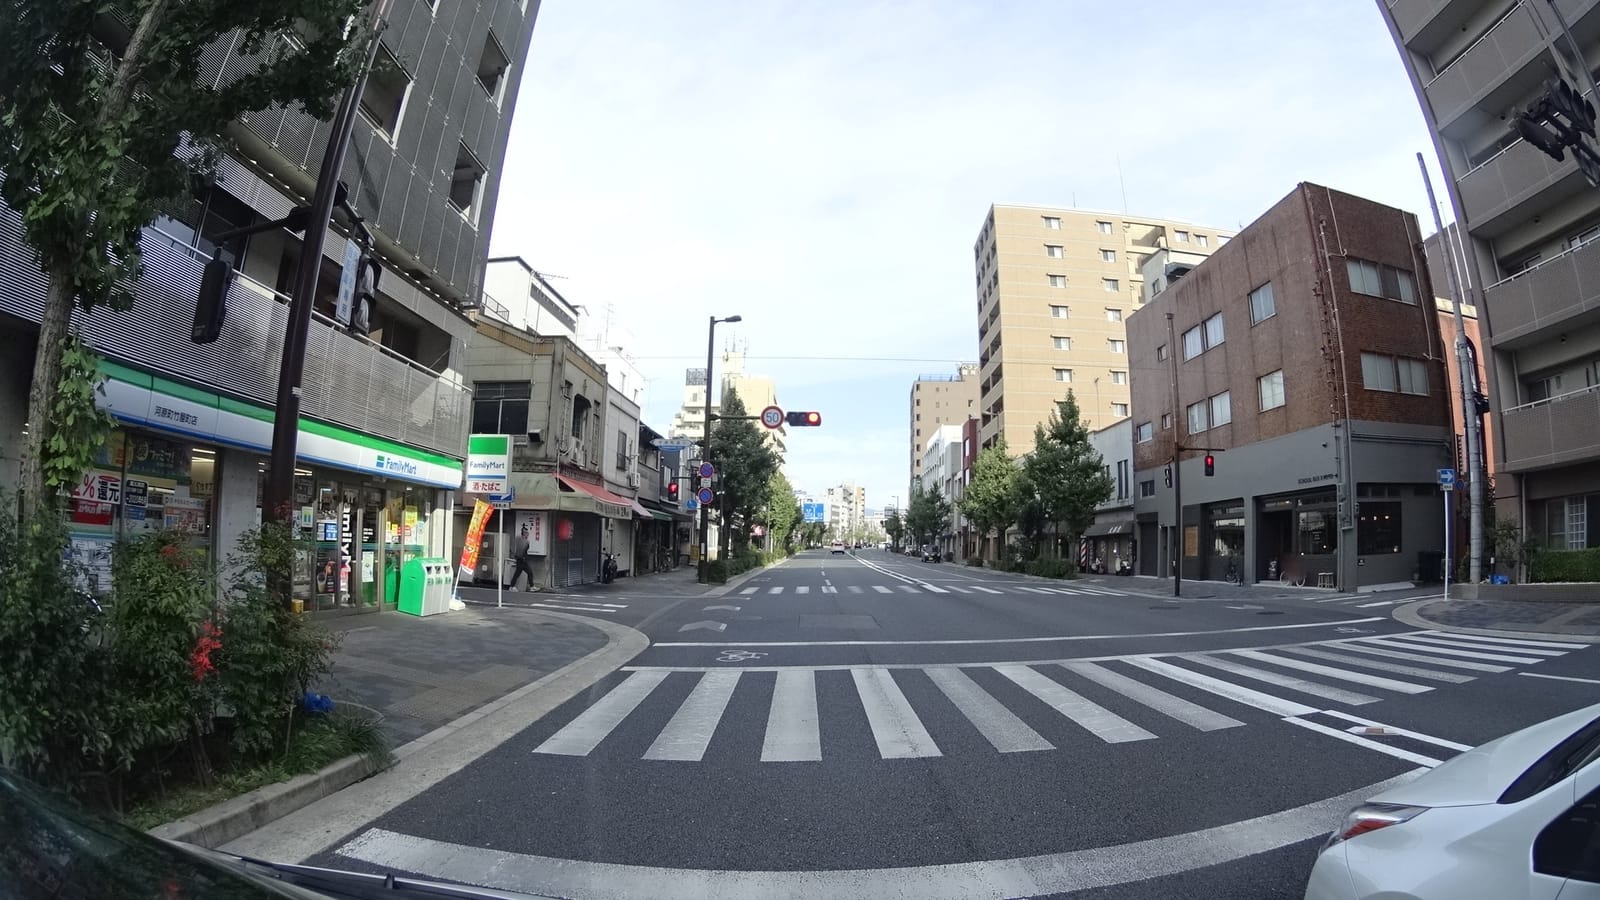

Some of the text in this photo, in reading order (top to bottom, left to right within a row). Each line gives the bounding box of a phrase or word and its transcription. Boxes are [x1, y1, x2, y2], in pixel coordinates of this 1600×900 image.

[766, 412, 779, 423] 50
[386, 457, 417, 475] FamilyMart
[469, 461, 505, 470] FamilyMart
